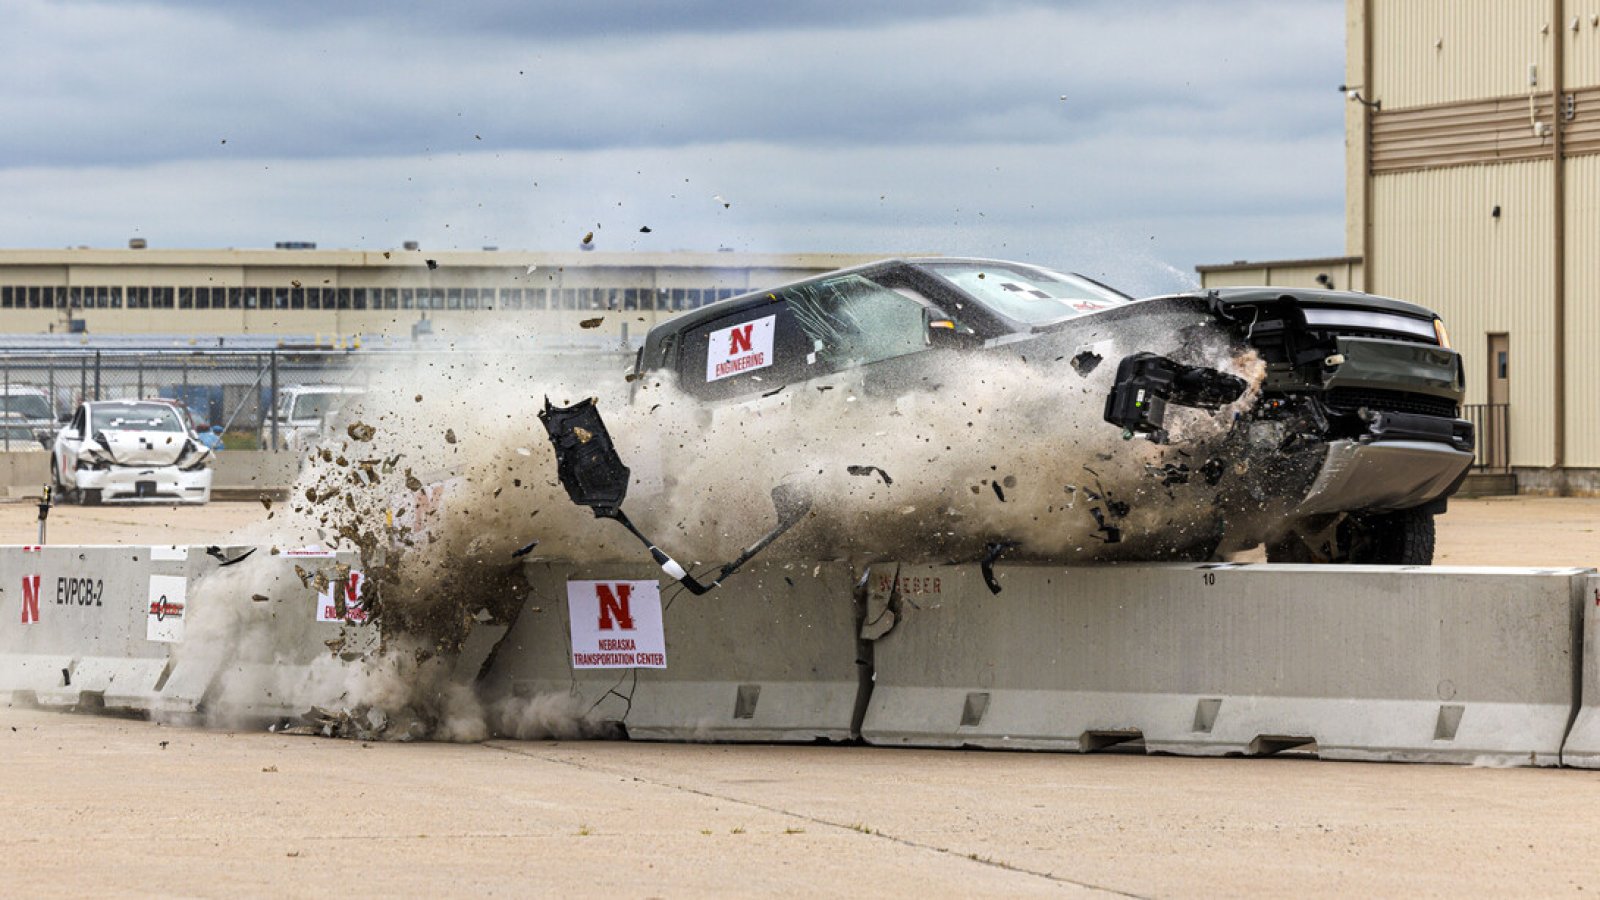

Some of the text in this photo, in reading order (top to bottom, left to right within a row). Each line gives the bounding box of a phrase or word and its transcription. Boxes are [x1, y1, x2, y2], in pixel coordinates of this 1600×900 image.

[729, 324, 753, 355] N
[715, 352, 764, 377] ENGINEERING
[57, 577, 103, 607] EVPCB-2
[1203, 573, 1215, 586] 10
[21, 575, 41, 624] N
[595, 584, 634, 630] N
[598, 639, 637, 651] NEBRASKA
[573, 652, 665, 666] TRANSPORTATION CENTER
